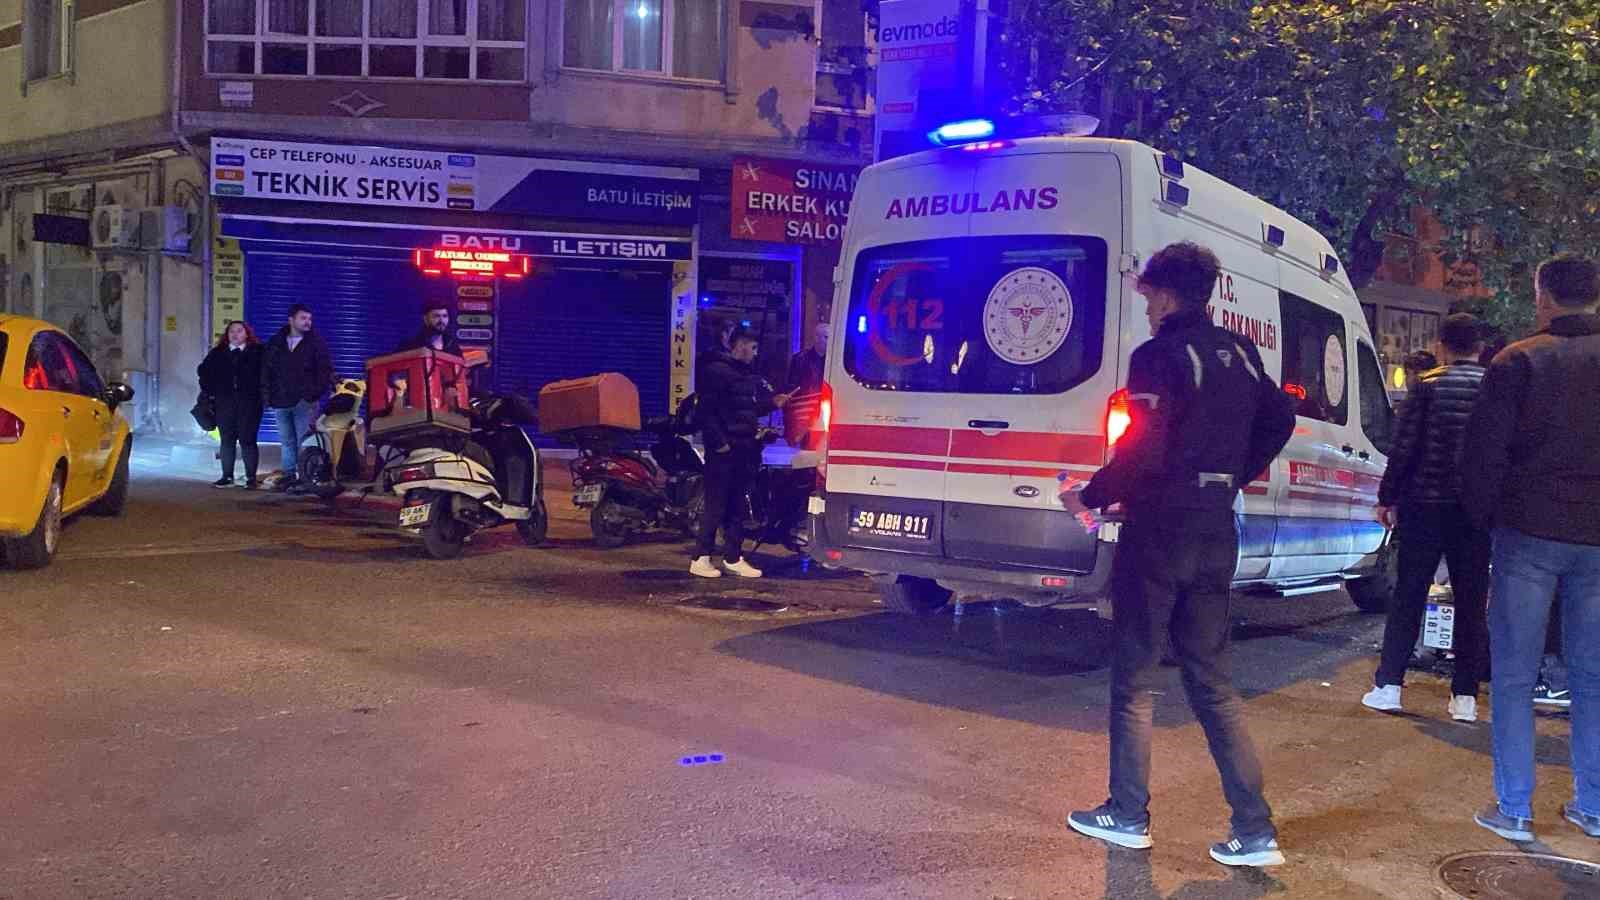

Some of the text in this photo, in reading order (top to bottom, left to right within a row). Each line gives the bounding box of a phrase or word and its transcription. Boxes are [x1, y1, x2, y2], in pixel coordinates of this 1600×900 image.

[249, 147, 277, 160] CEP
[280, 149, 356, 165] TELEFONU
[369, 156, 442, 170] AKSESUAR
[252, 170, 348, 198] TEKNİK
[356, 176, 441, 203] SERVİS
[587, 188, 692, 211] BATU İLETİŞİM
[748, 191, 818, 215] ERKEK
[885, 186, 1059, 220] AMBULANS
[441, 234, 521, 251] BATU
[1218, 272, 1238, 303] T.C.
[885, 299, 944, 330] 112
[1222, 309, 1277, 350] BAKANLIĞI
[858, 511, 929, 535] 59 ABH 911
[1441, 607, 1453, 621] 59
